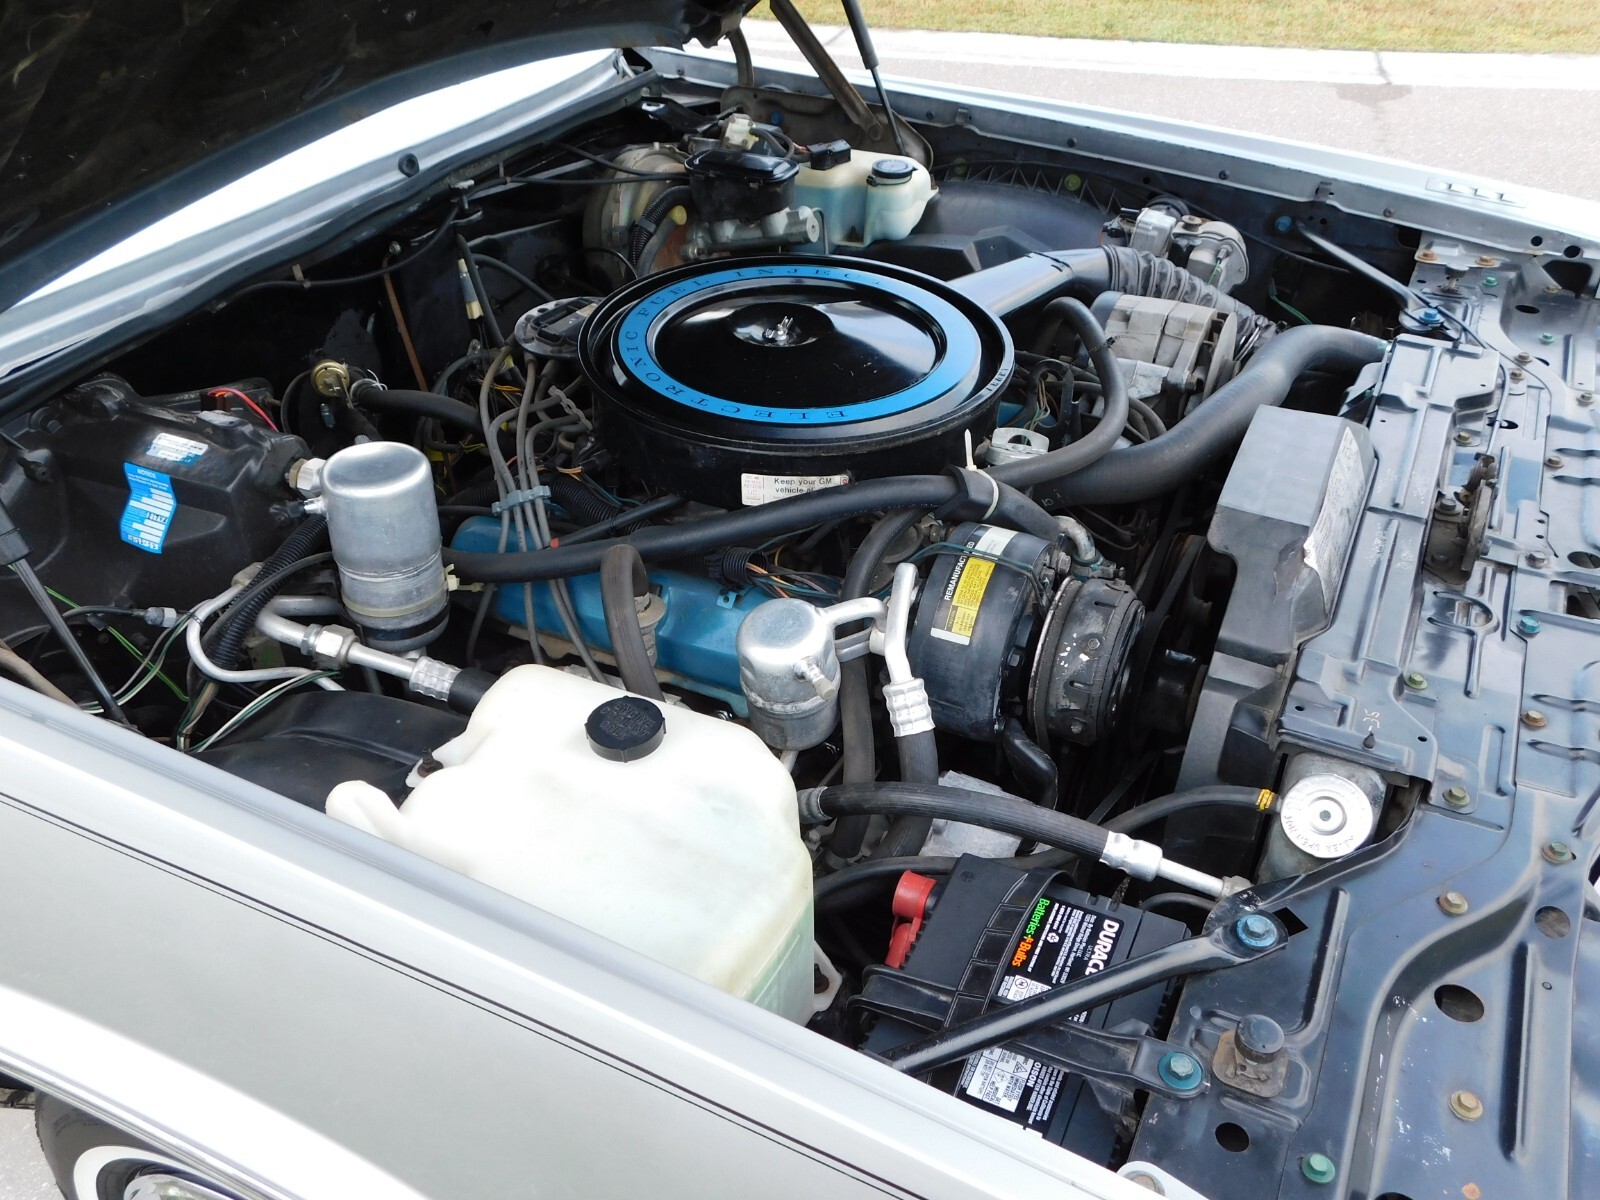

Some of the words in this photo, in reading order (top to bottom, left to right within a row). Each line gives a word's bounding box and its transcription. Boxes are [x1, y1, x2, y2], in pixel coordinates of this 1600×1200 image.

[637, 279, 710, 318] FUEL
[774, 478, 796, 486] Keep
[775, 486, 804, 494] vehicle
[944, 541, 975, 601] REMANUFACTED
[1026, 898, 1050, 935] Batteries
[1012, 941, 1032, 967] Bulbs
[1085, 919, 1119, 975] DURAC
[1026, 1062, 1041, 1087] OISON
